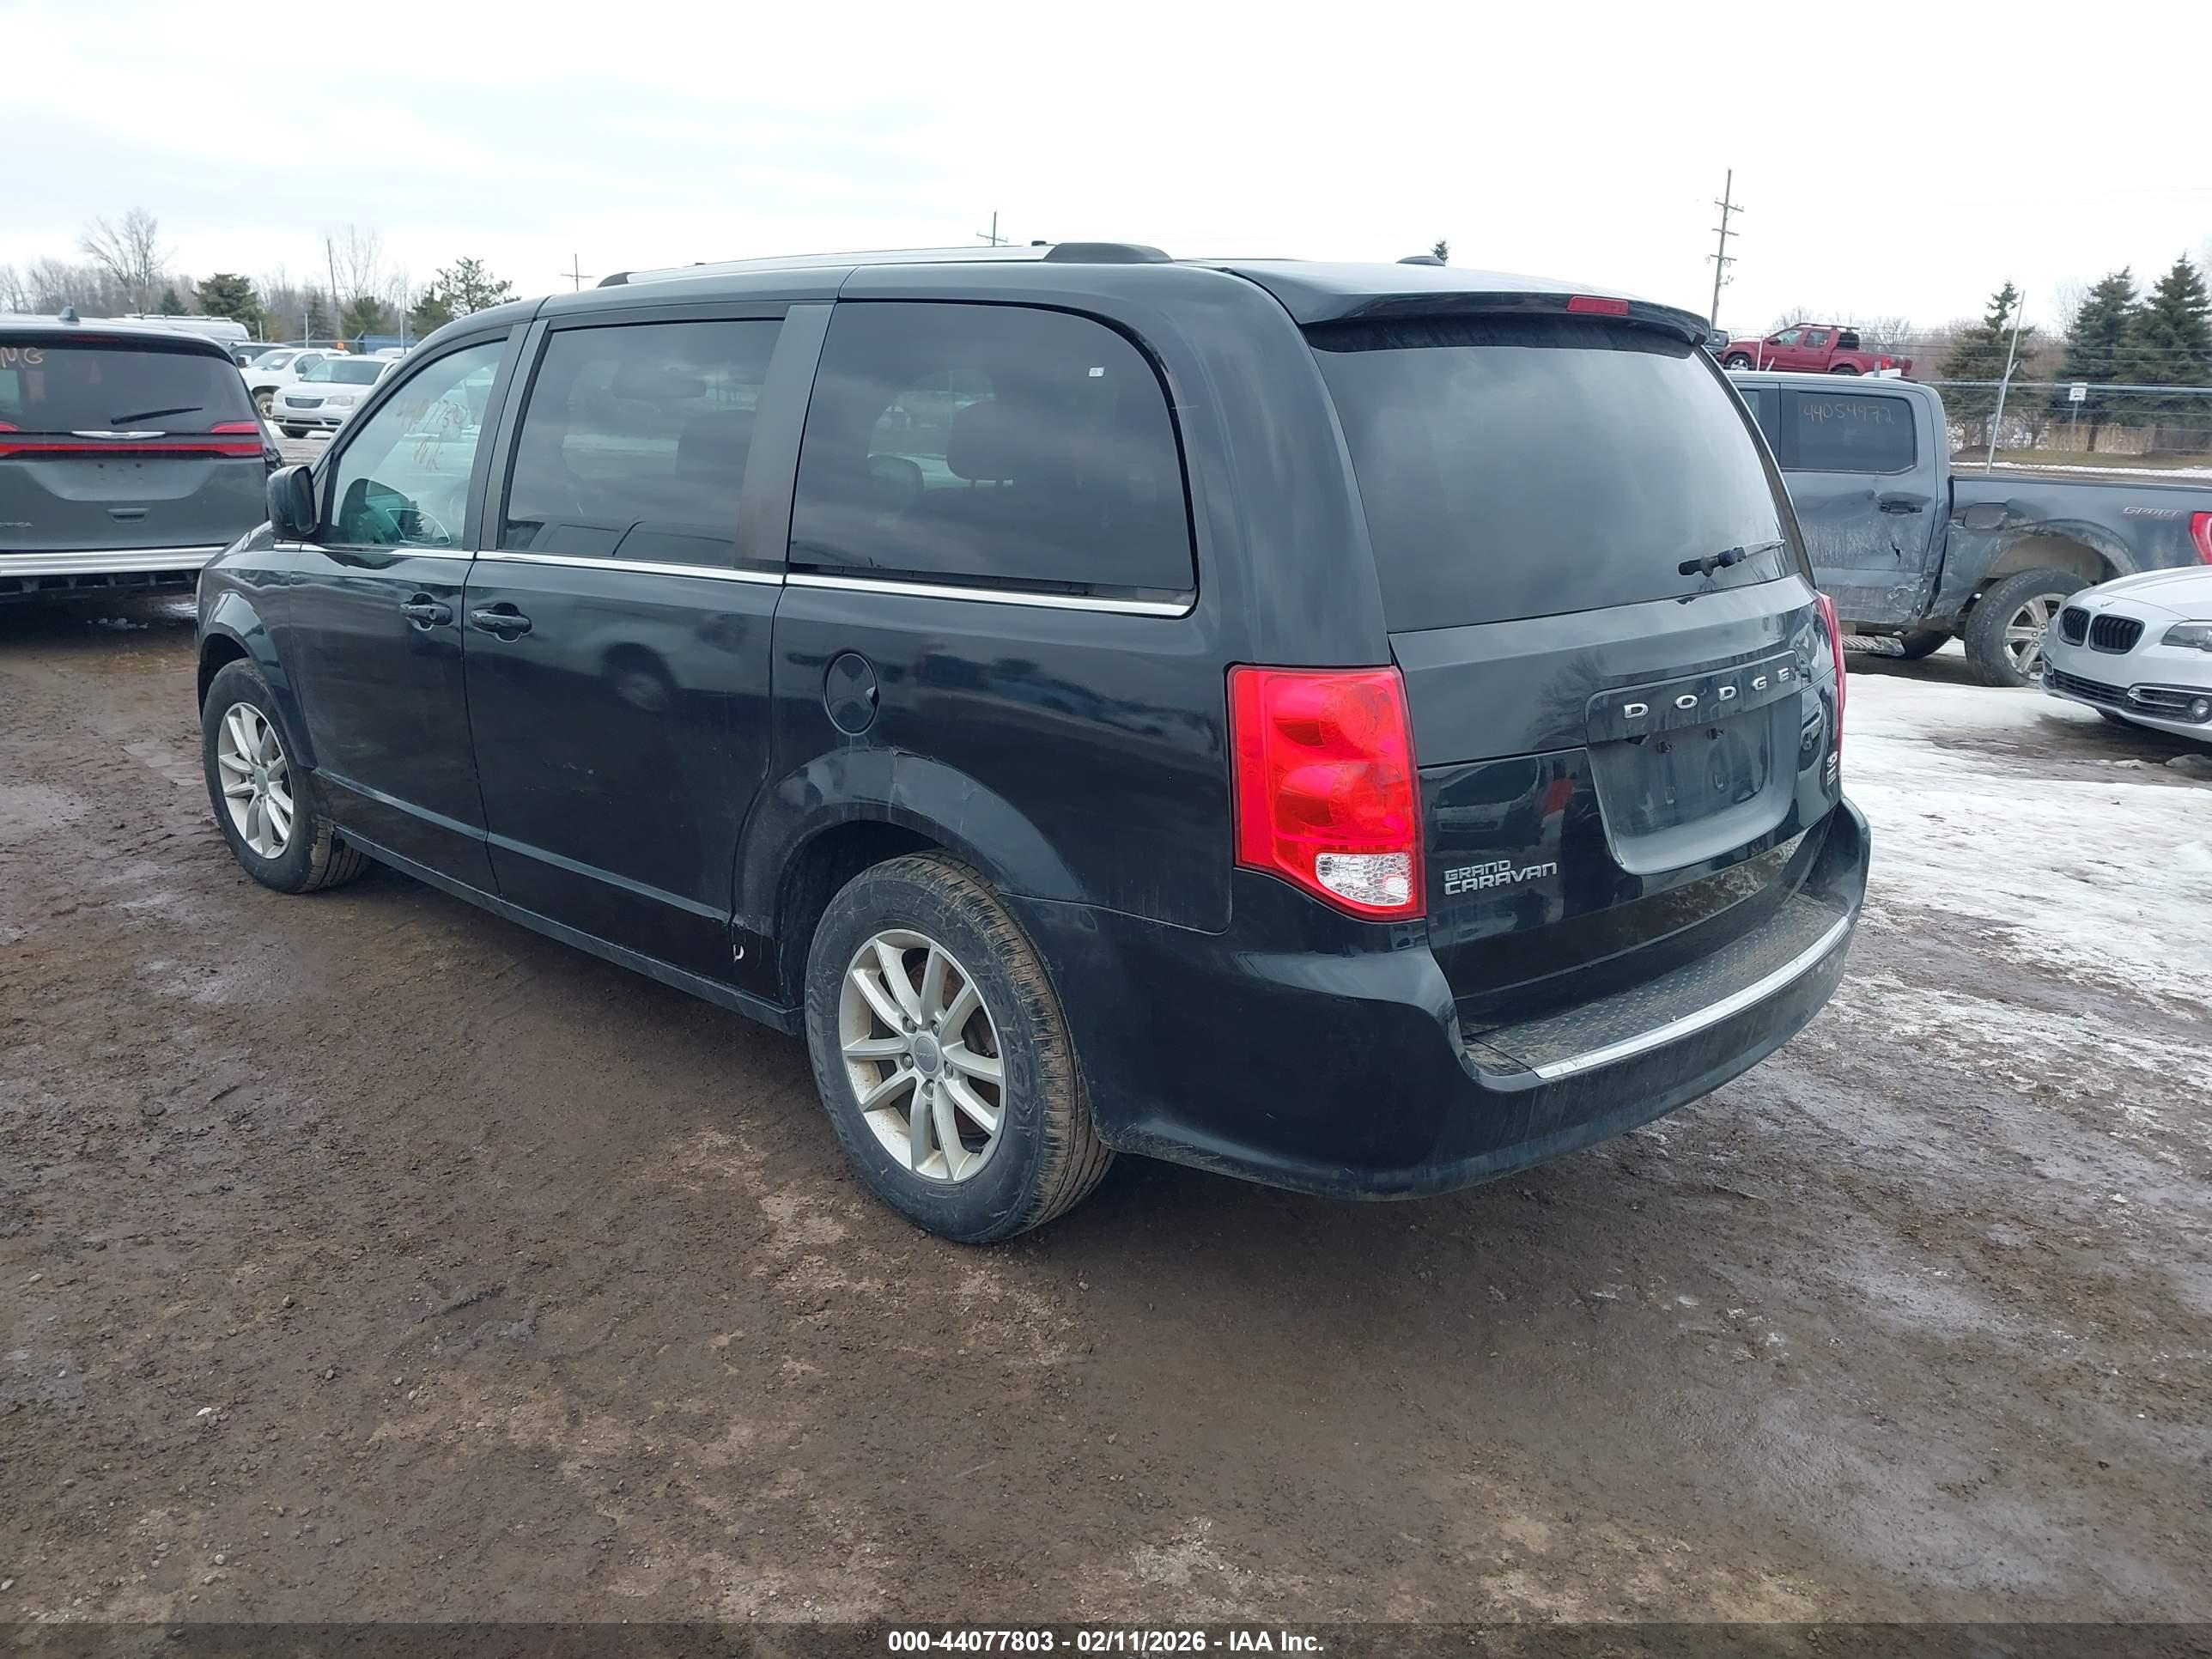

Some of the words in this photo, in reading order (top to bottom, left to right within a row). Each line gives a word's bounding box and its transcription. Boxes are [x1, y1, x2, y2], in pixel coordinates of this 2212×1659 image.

[1804, 402, 1896, 425] 44054972
[2122, 507, 2185, 517] SPORT
[1624, 667, 1790, 720] DODGE
[1444, 860, 1512, 882] GRAND
[1444, 862, 1558, 896] CARAVAN
